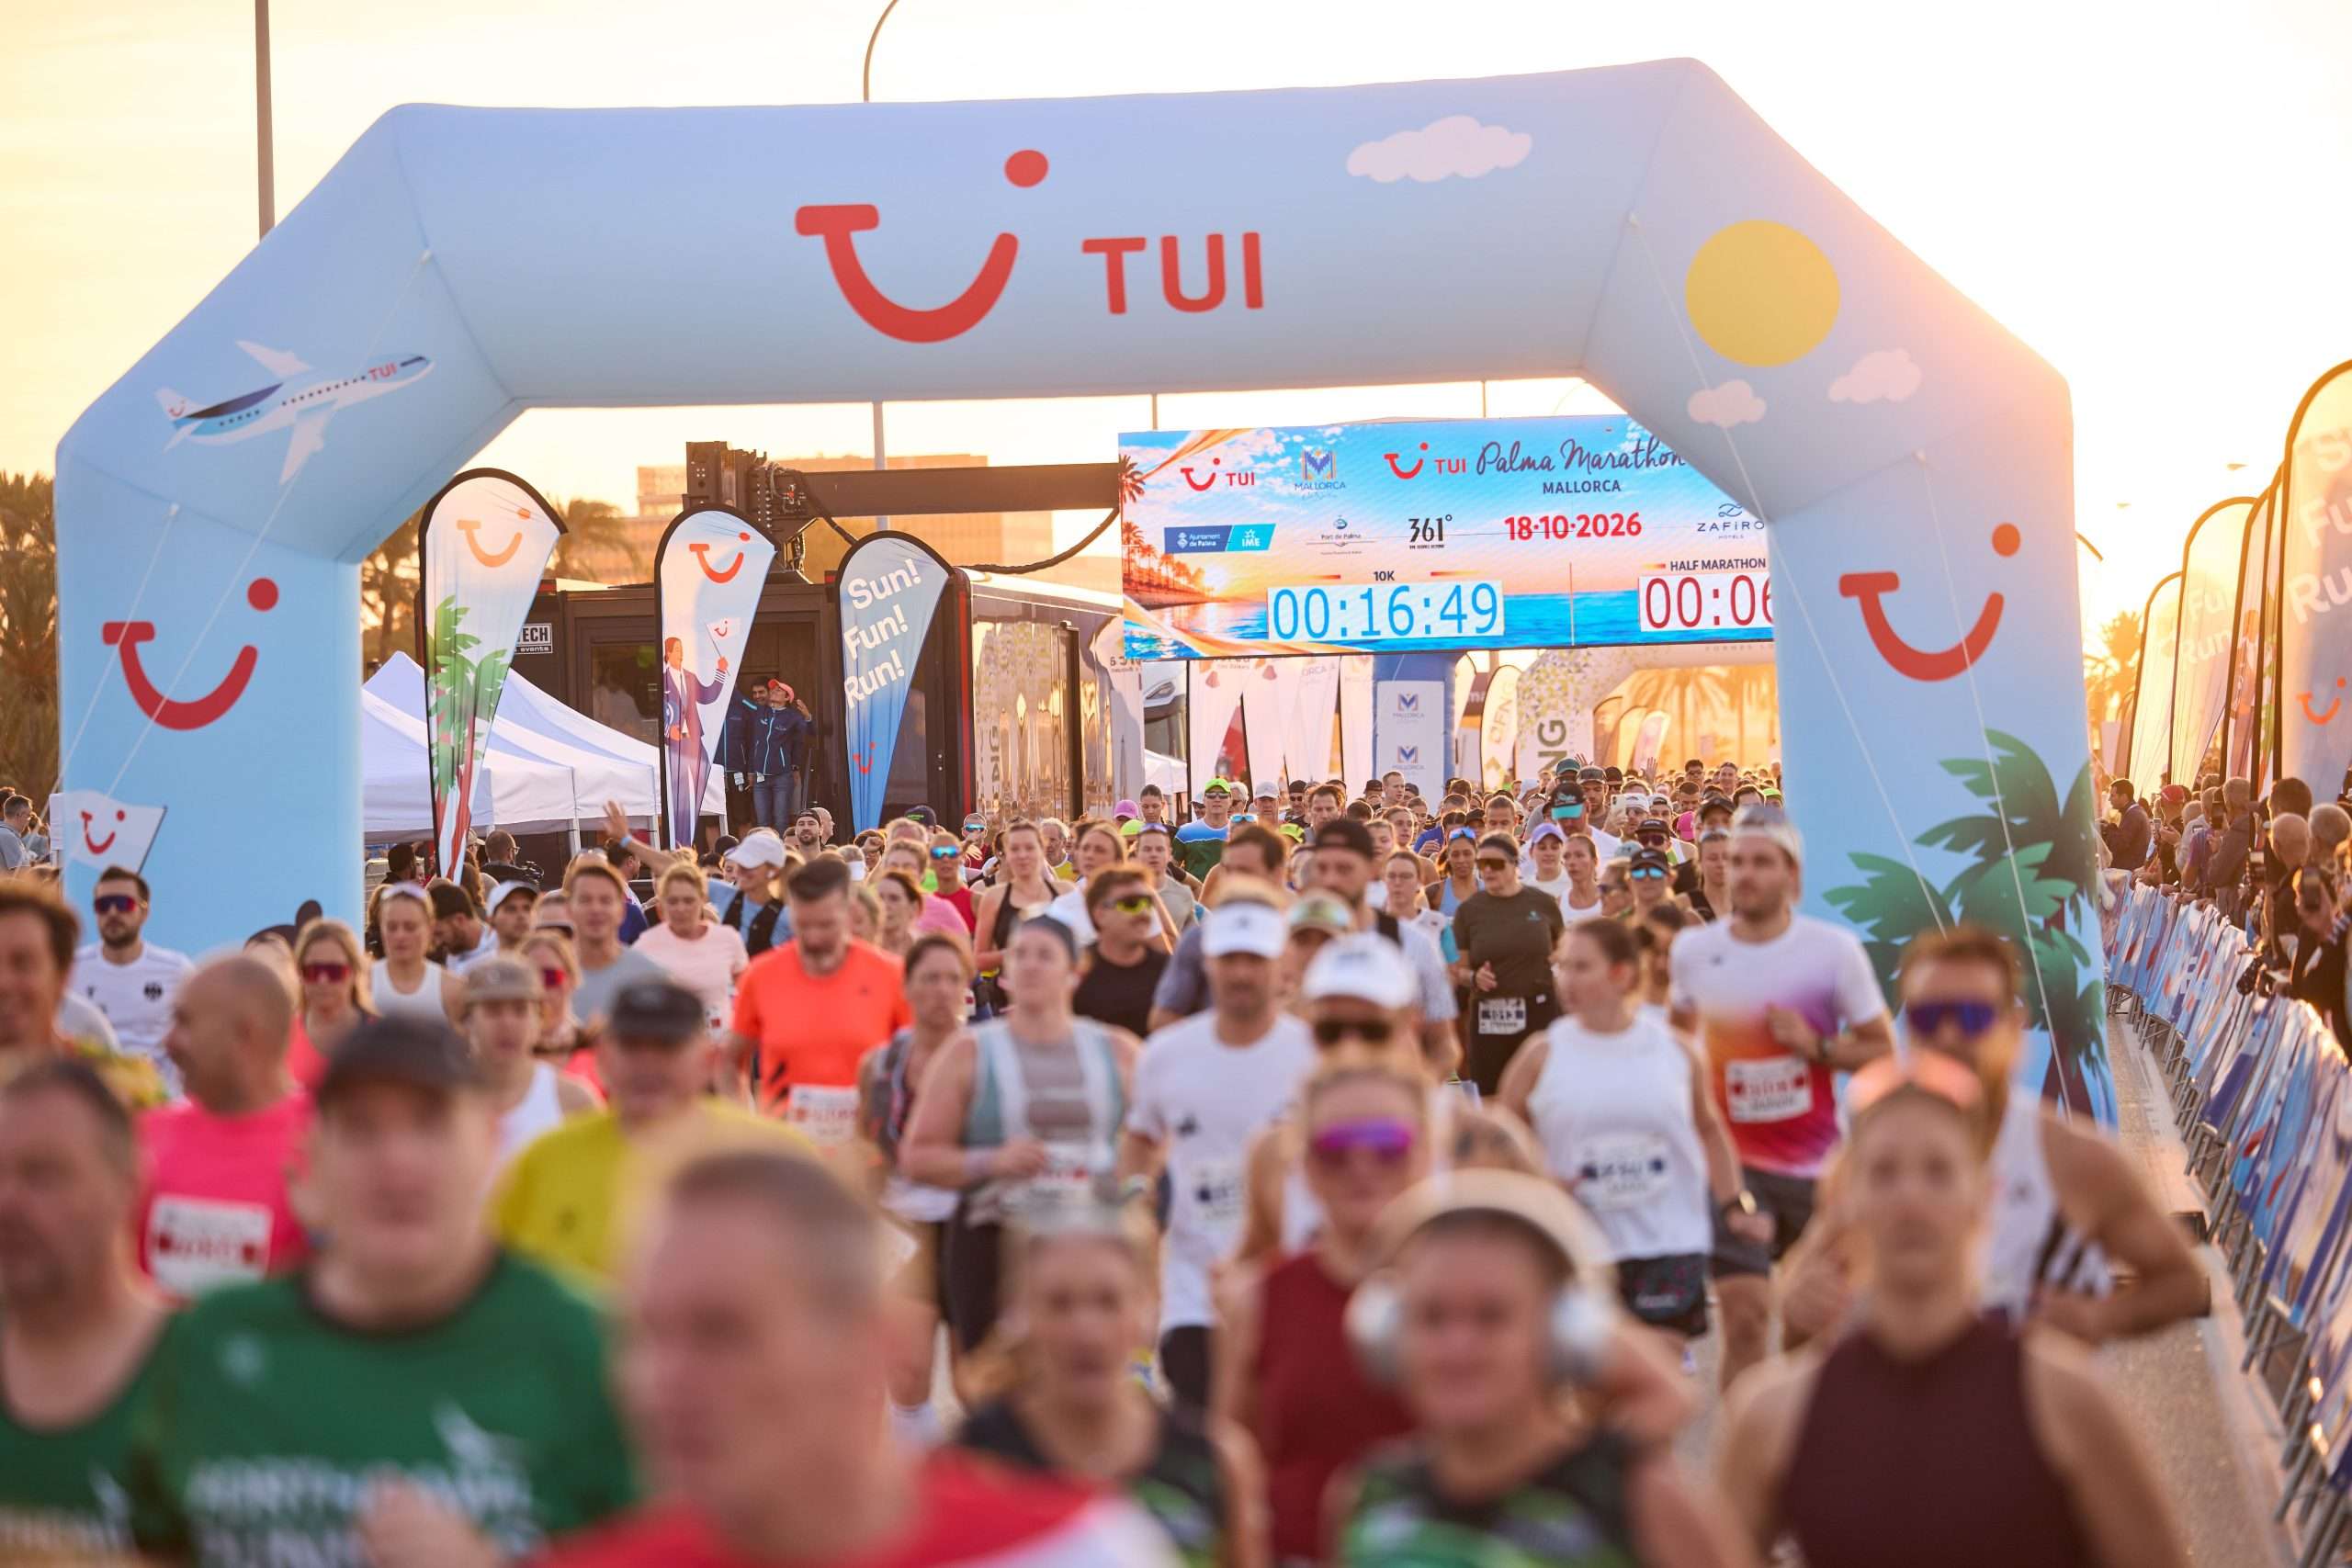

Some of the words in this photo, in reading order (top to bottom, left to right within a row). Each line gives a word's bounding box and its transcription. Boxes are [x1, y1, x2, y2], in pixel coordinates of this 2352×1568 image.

[1081, 231, 1264, 314] TUI
[368, 362, 397, 381] TUI
[1435, 458, 1466, 474] TUI
[1476, 441, 1555, 475] Palma
[1560, 435, 1686, 474] Marathon
[1226, 471, 1255, 487] TUI
[1295, 480, 1347, 491] MALLORCA
[1543, 479, 1621, 494] MALLORCA
[1242, 537, 1261, 547] IME
[1670, 560, 1699, 571] HALF
[1702, 558, 1767, 570] MARATHON
[848, 558, 922, 610] Sun!
[1374, 570, 1396, 581] 10K
[1272, 582, 1498, 640] 00:16:49
[519, 627, 548, 642] ECH
[843, 604, 909, 660] Fun!
[843, 649, 905, 709] Run!
